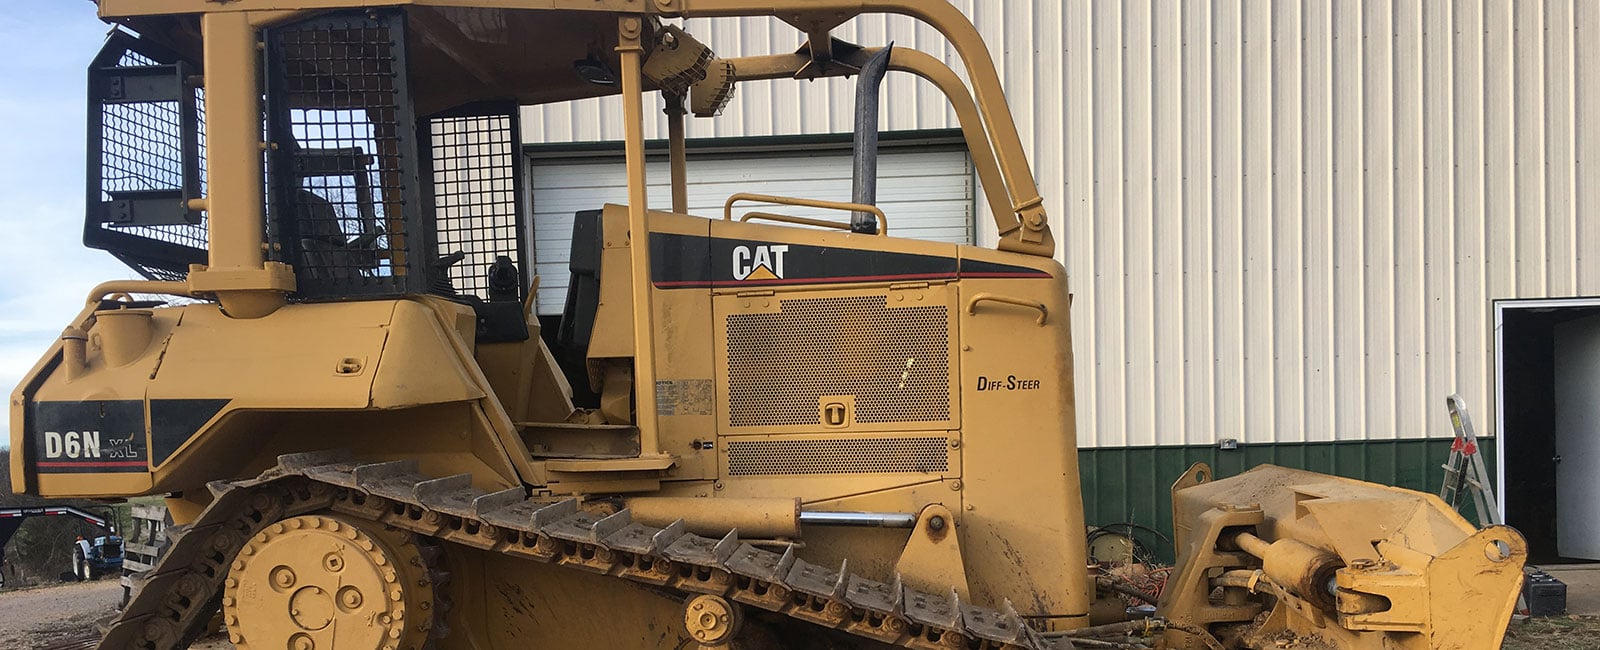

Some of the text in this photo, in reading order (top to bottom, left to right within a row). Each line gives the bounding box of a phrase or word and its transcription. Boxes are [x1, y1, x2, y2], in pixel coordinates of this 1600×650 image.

[732, 244, 789, 281] CAT
[44, 431, 138, 459] D6N XL
